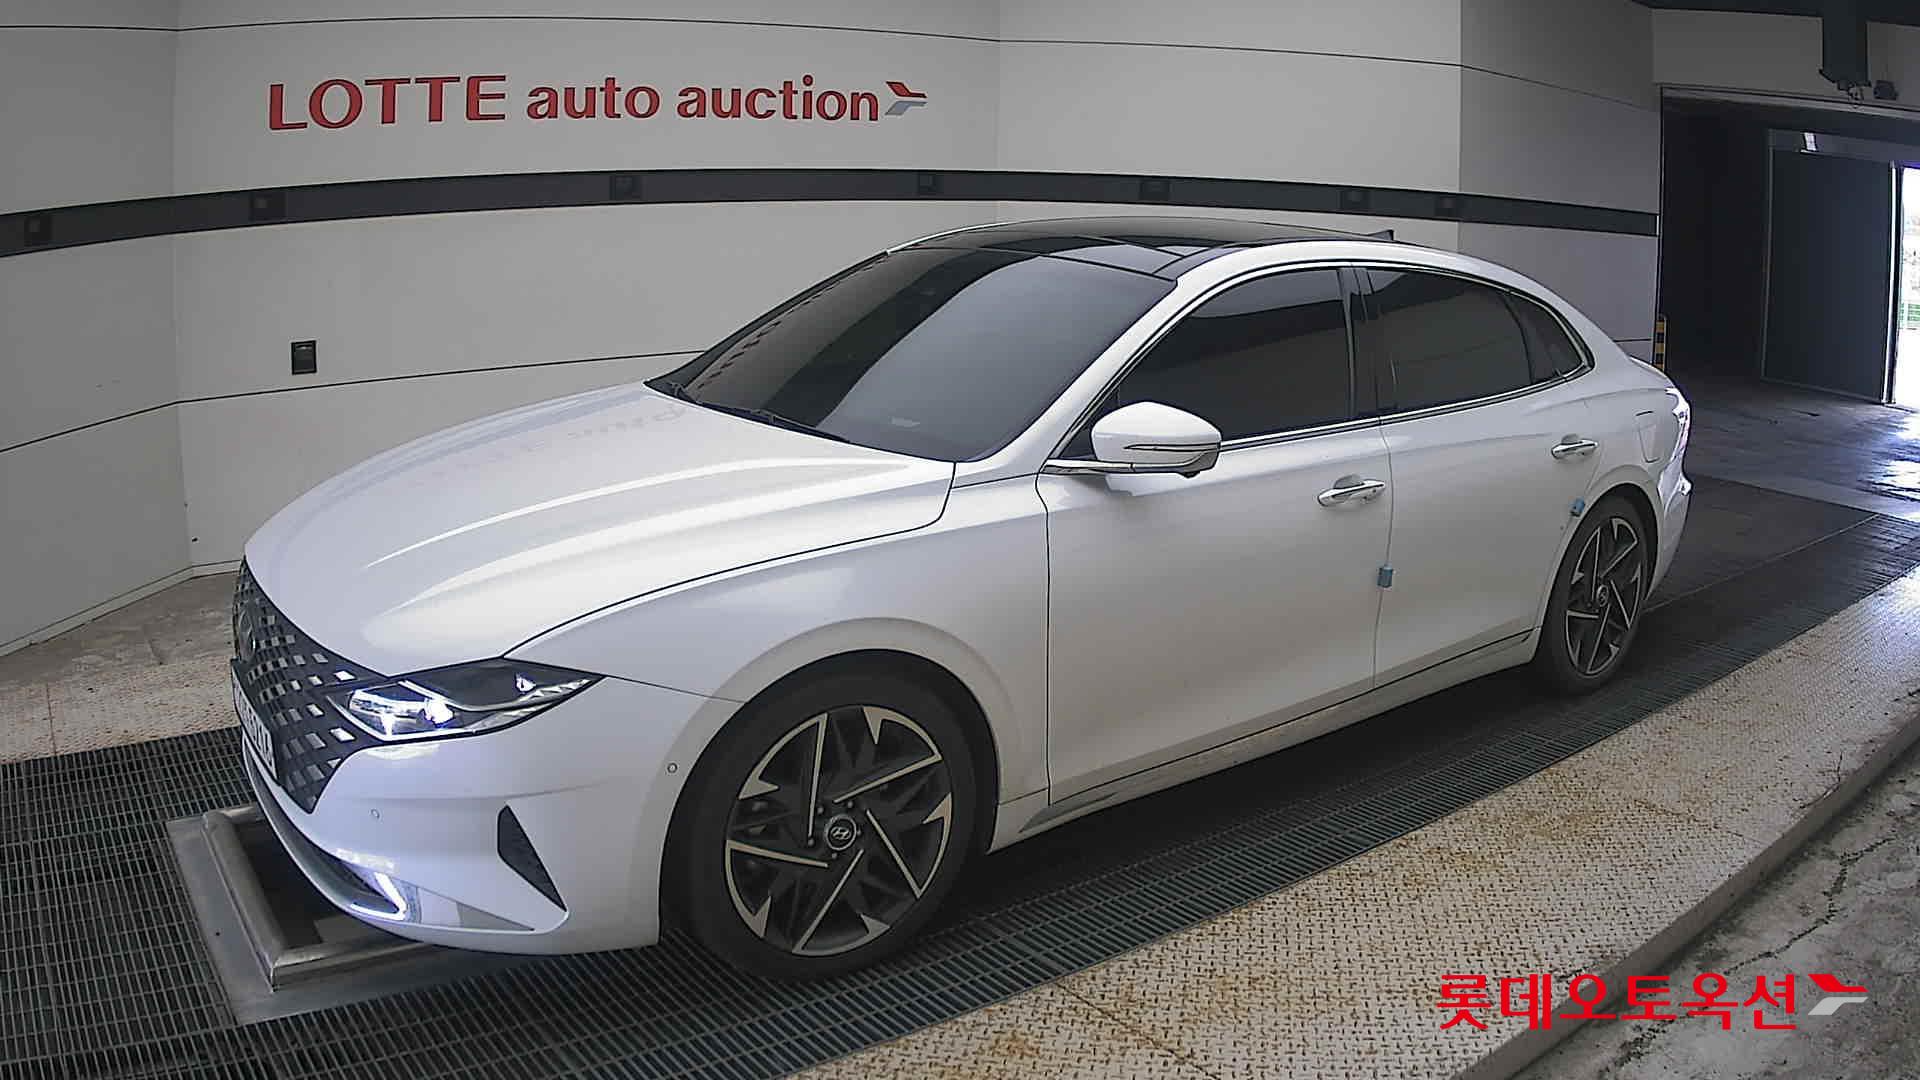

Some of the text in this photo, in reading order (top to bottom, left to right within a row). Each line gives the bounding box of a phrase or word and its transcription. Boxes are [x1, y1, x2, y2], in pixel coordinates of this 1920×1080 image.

[268, 74, 880, 131] LOTTE auto auction
